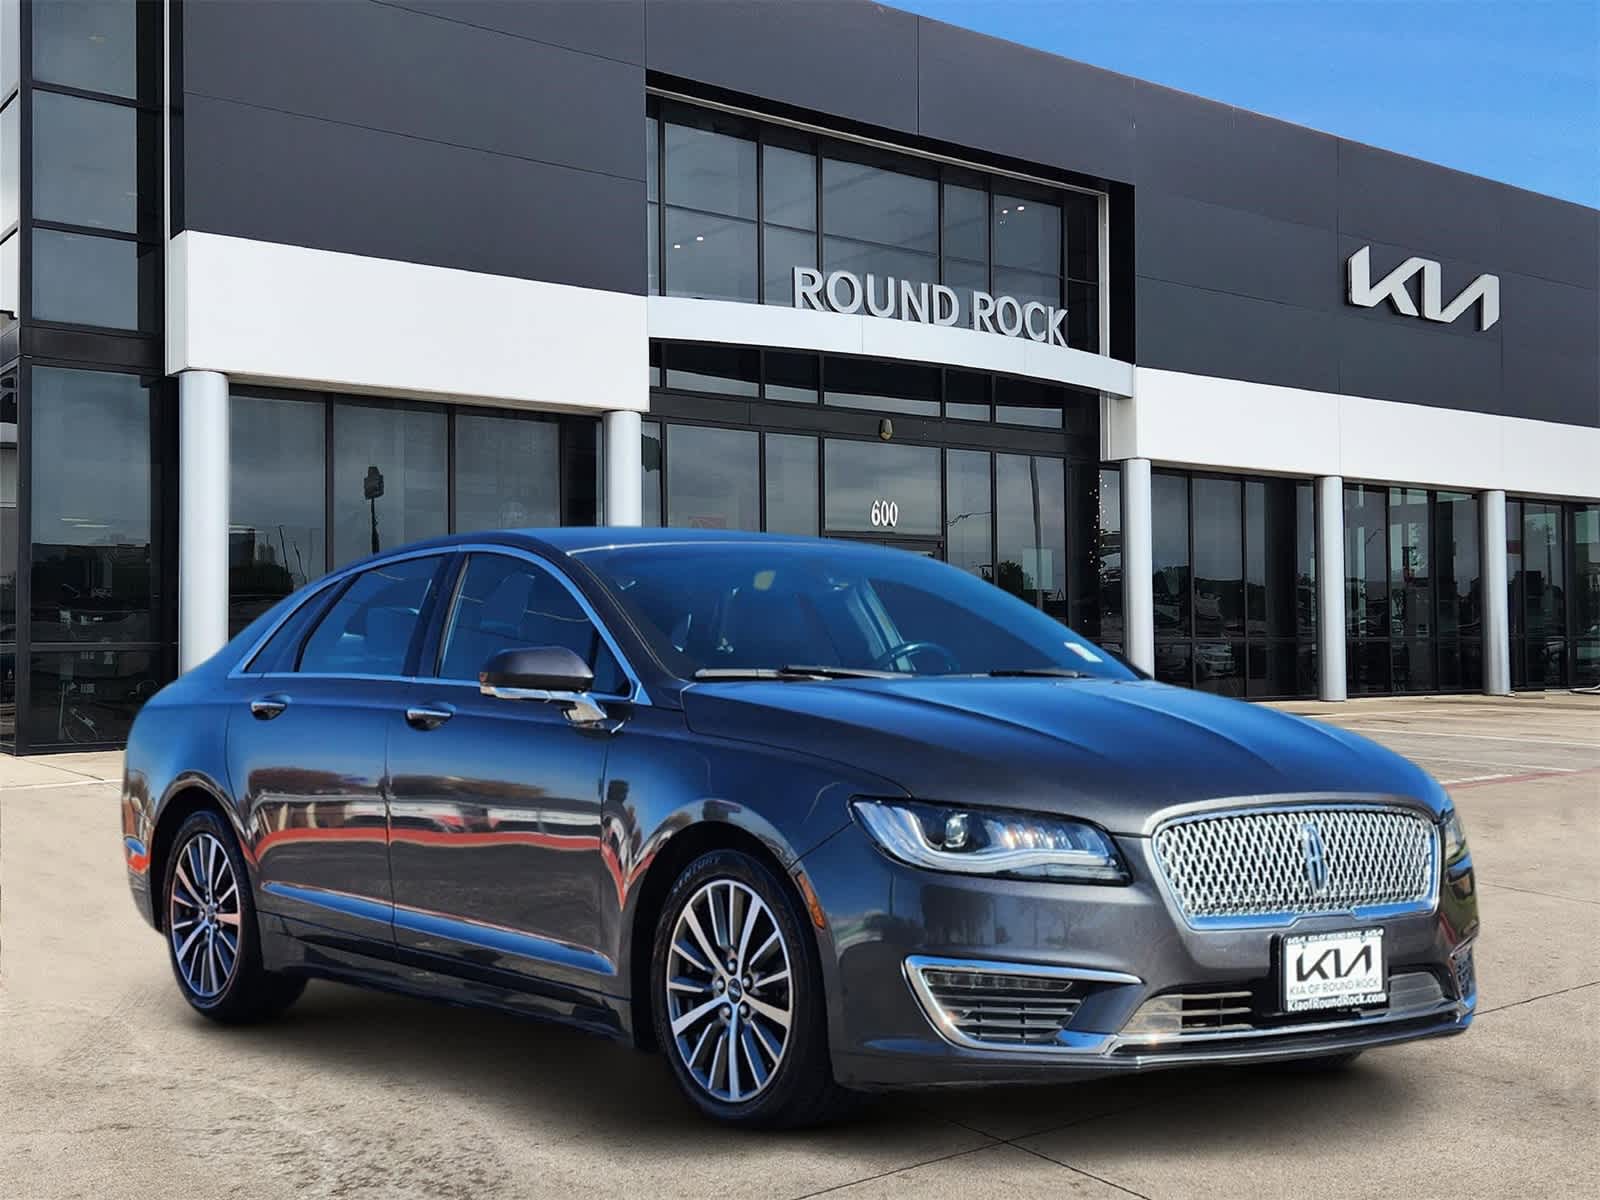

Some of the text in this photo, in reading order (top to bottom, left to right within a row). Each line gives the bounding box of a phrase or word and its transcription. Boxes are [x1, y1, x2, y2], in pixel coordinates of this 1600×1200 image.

[792, 266, 1068, 347] ROUND ROCK
[1348, 245, 1500, 331] KIA
[870, 499, 899, 527] 600
[1296, 945, 1372, 982] KIA
[1289, 978, 1379, 995] KIA OF ROUND ROCK
